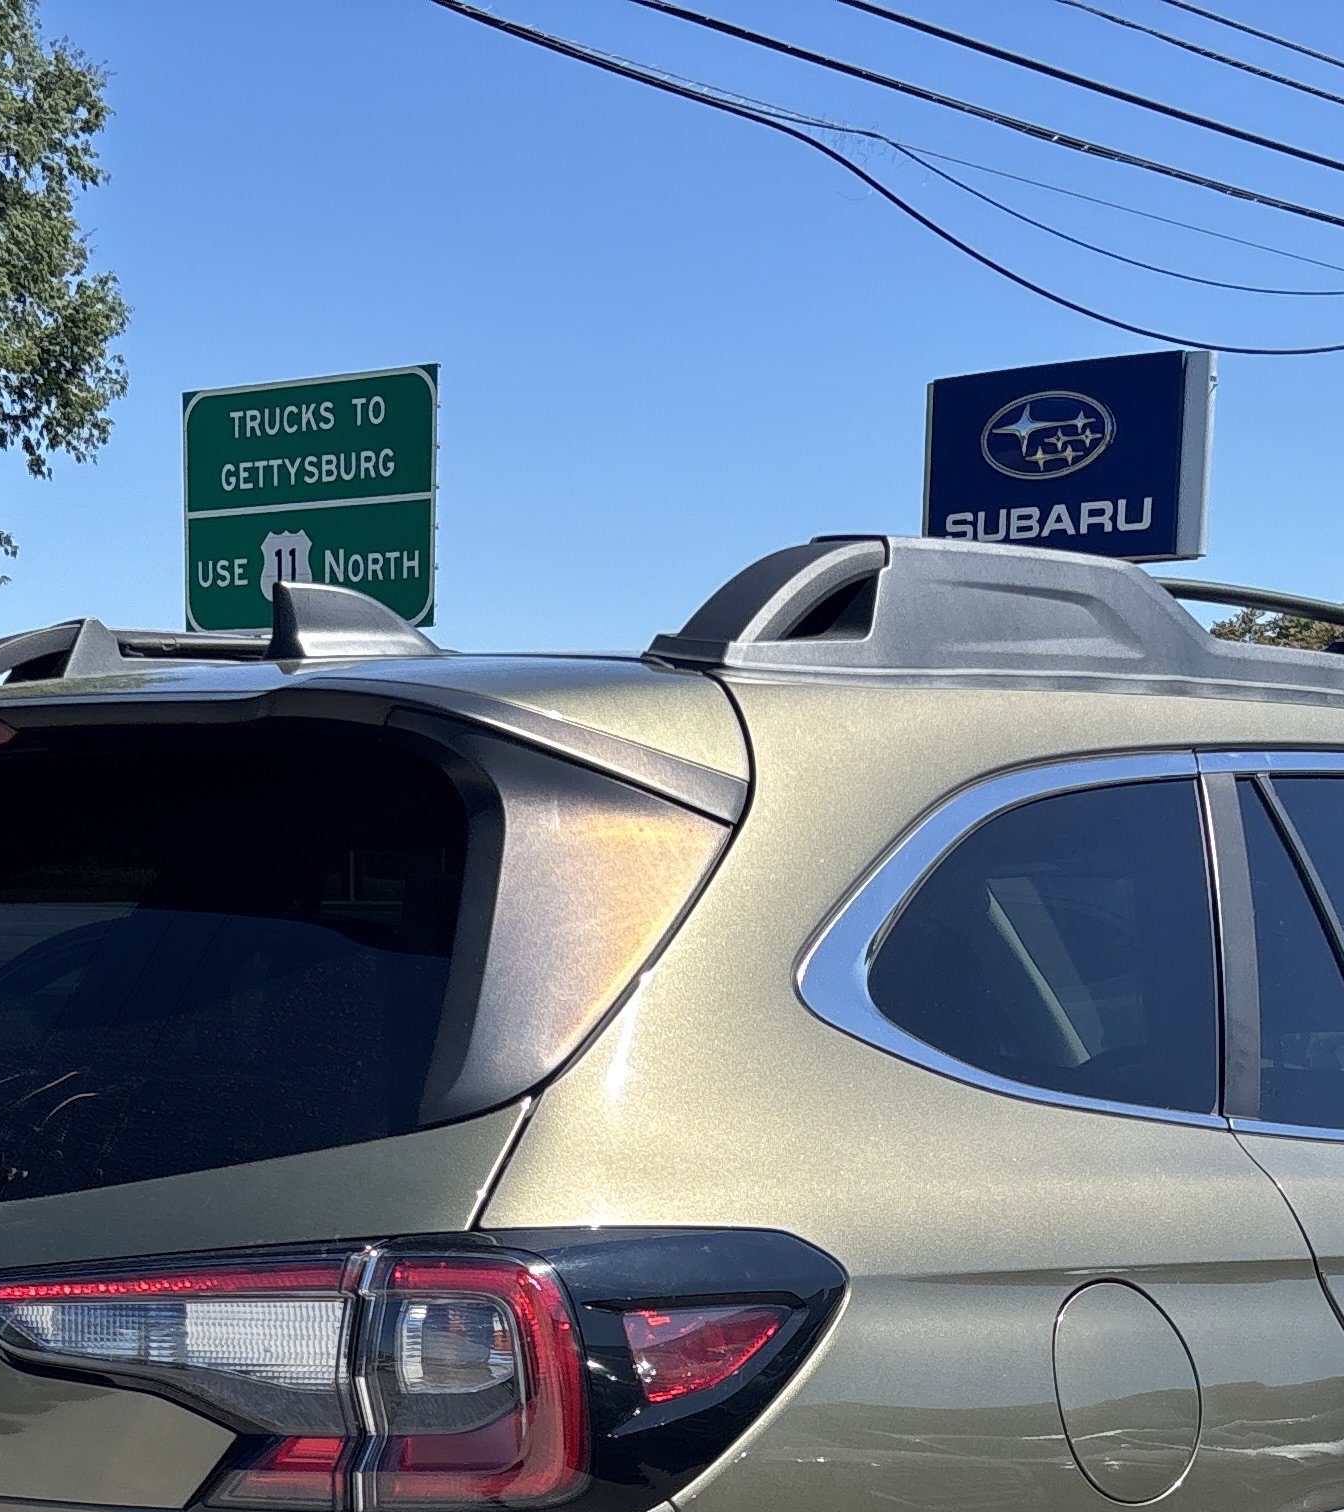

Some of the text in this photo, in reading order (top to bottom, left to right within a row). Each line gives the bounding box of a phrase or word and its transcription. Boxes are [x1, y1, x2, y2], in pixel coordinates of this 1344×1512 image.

[229, 395, 386, 439] TRUCKS TO
[221, 448, 396, 492] GETTYSBURG
[945, 496, 1154, 543] SUBARU
[197, 547, 420, 589] USE 11 NORTH
